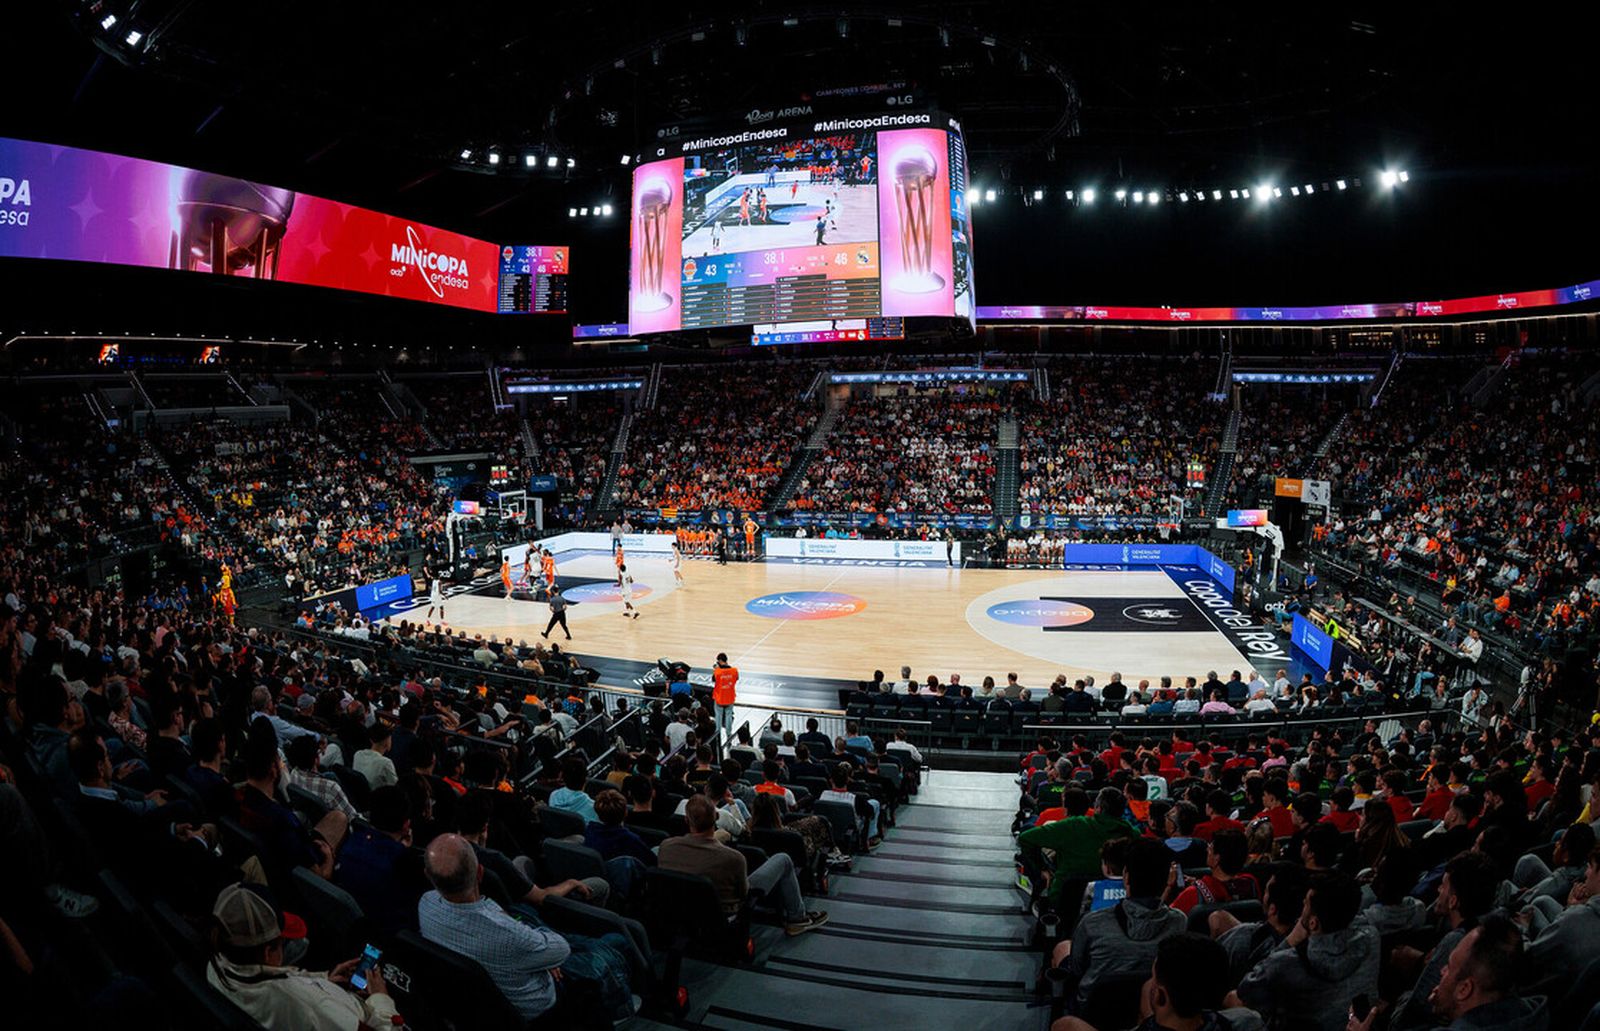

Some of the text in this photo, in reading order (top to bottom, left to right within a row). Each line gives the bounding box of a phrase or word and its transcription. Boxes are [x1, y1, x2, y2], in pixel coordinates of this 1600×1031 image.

[898, 95, 913, 105] LG
[777, 106, 813, 118] ARENA
[814, 114, 930, 132] #MinicopaEndesa
[666, 126, 680, 137] LG
[682, 128, 788, 151] #MinicopaEndesa
[764, 251, 785, 265] 38.1
[705, 264, 717, 276] 43
[430, 272, 469, 290] endesa
[791, 557, 927, 567] VALENCIA
[1184, 580, 1233, 608] Copa
[994, 608, 1088, 617] endesa
[1214, 608, 1265, 630] del
[1236, 632, 1293, 662] Rey
[1150, 786, 1161, 800] 2
